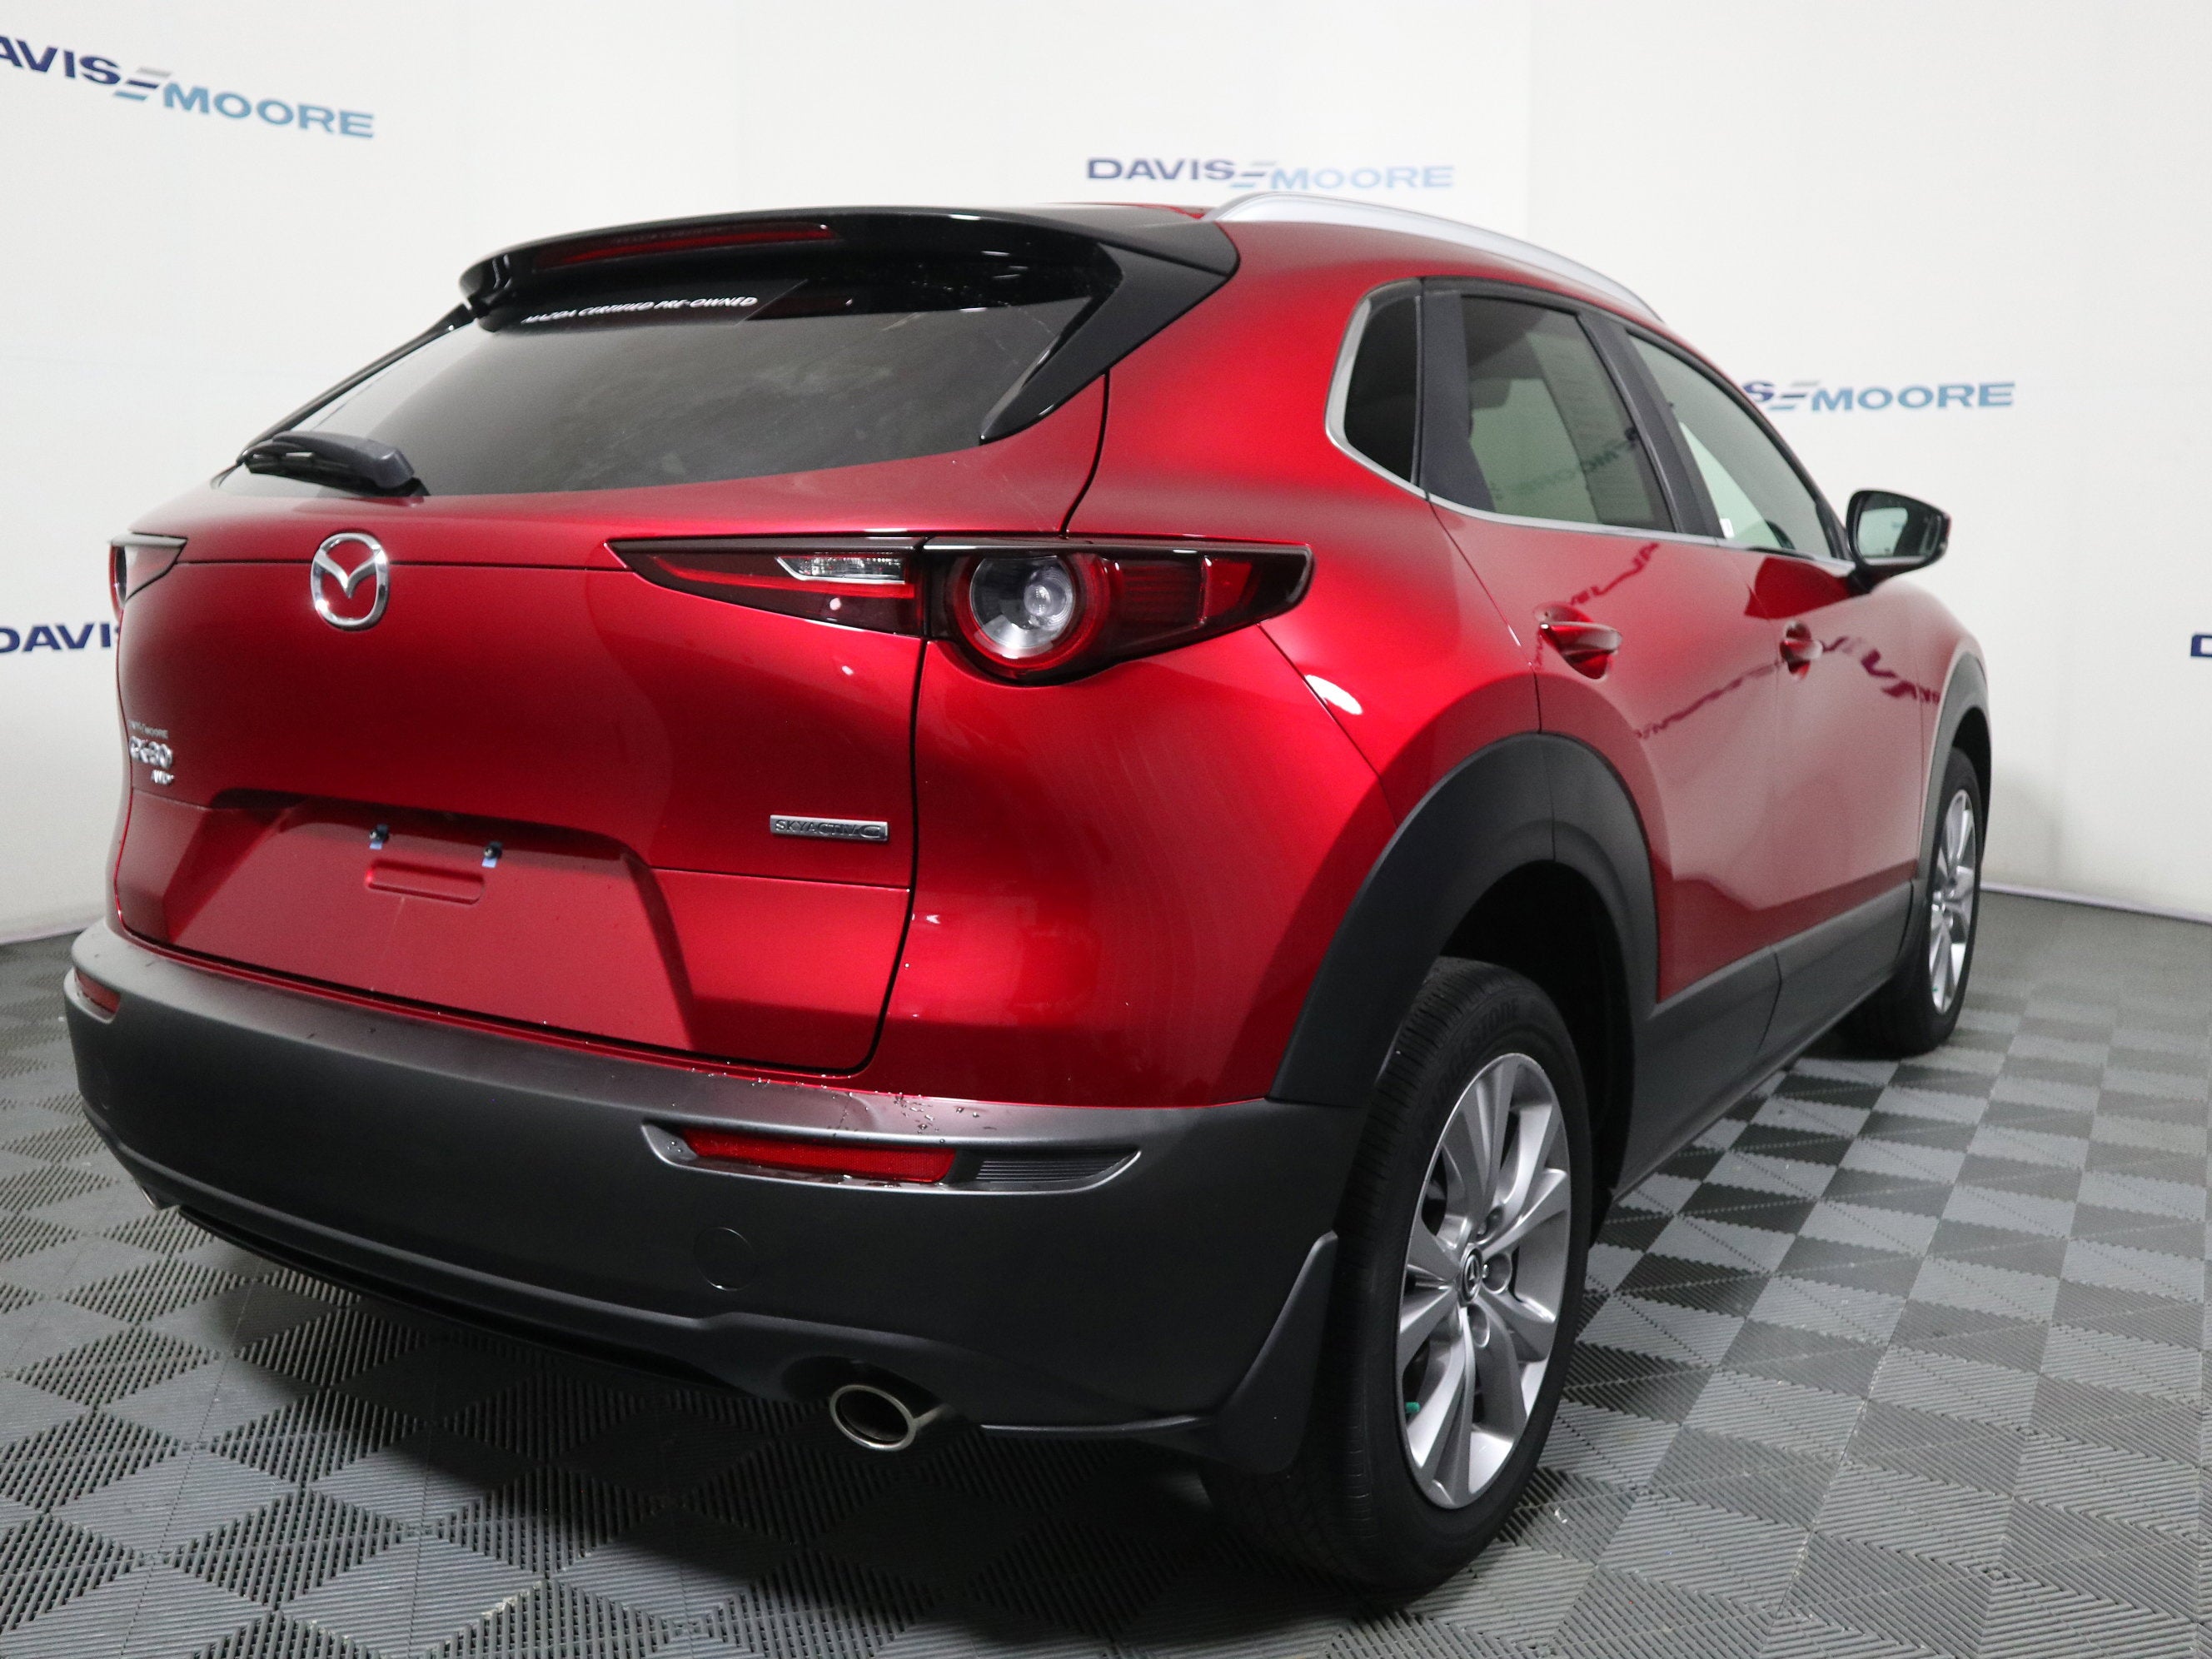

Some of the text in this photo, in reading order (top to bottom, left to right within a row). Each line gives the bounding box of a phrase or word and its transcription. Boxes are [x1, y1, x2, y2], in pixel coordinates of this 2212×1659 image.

[163, 82, 374, 137] MOORE
[1088, 158, 1454, 190] DAVIS MOORE
[1811, 381, 2015, 411] MOORE
